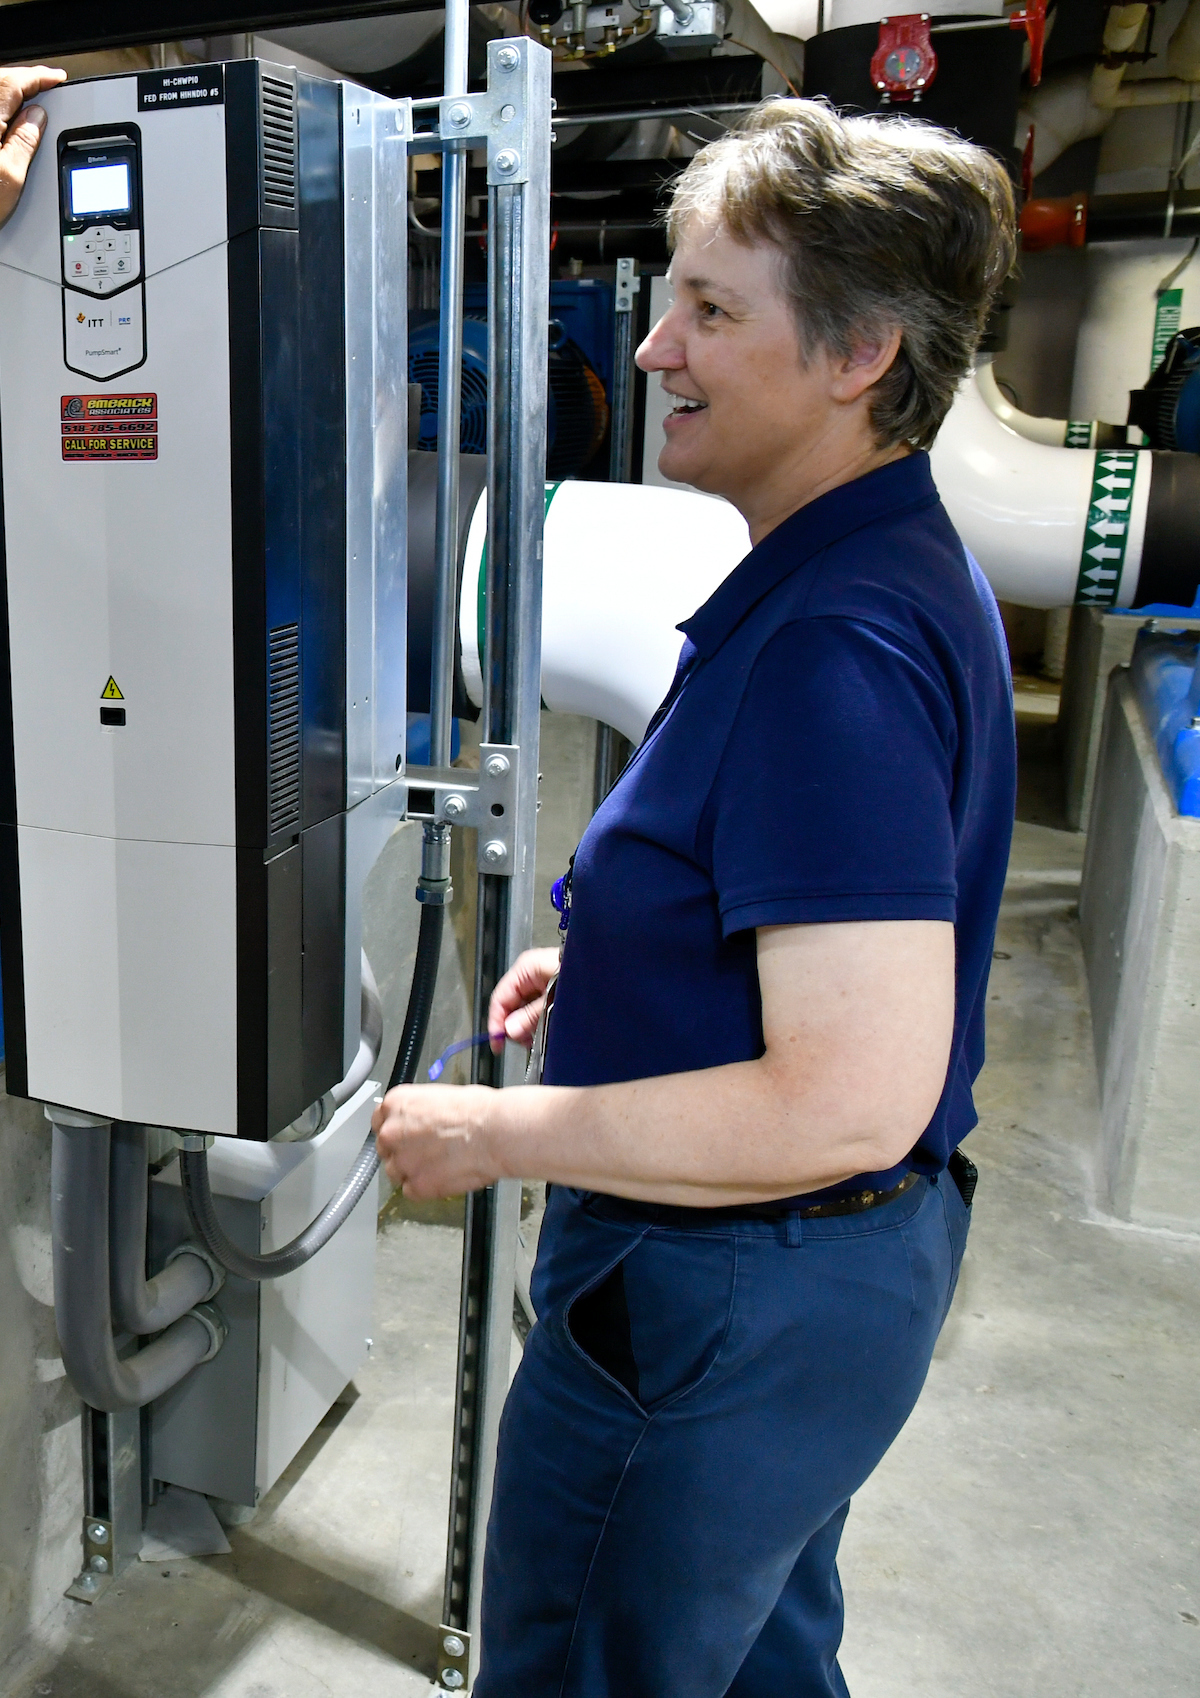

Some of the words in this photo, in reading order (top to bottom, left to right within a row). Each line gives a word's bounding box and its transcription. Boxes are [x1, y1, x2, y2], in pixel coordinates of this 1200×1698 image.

[143, 94, 157, 103] FED
[159, 92, 178, 101] FROM
[88, 319, 104, 328] ITT
[89, 407, 152, 415] ASSOCIATES
[65, 440, 86, 450] CALL
[88, 440, 107, 449] FOR
[110, 438, 154, 449] SERVICE
